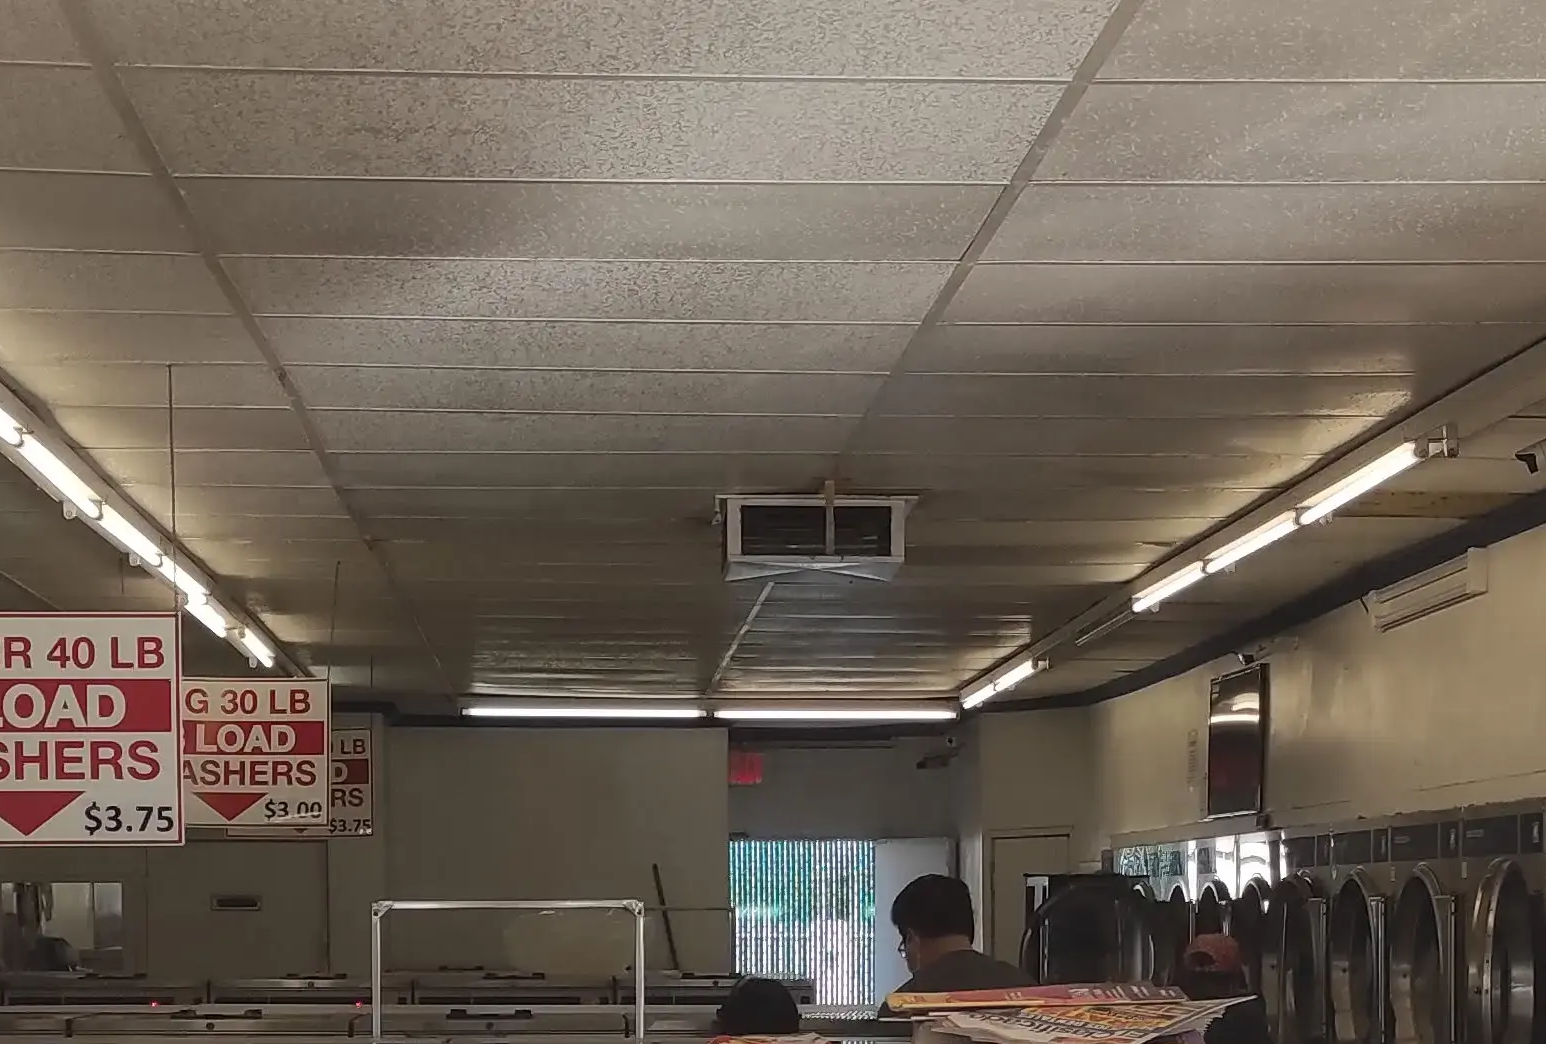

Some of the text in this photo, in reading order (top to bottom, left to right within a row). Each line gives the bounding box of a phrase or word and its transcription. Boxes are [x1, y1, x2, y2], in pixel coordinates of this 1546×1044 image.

[46, 637, 95, 669] 40
[111, 637, 165, 669] LB
[221, 689, 258, 714] 30
[269, 689, 311, 714] LB
[196, 723, 296, 753] LOAD
[340, 739, 366, 754] LB
[84, 802, 174, 836] $3.75
[264, 799, 322, 819] $3.00
[329, 819, 372, 834] $3.75
